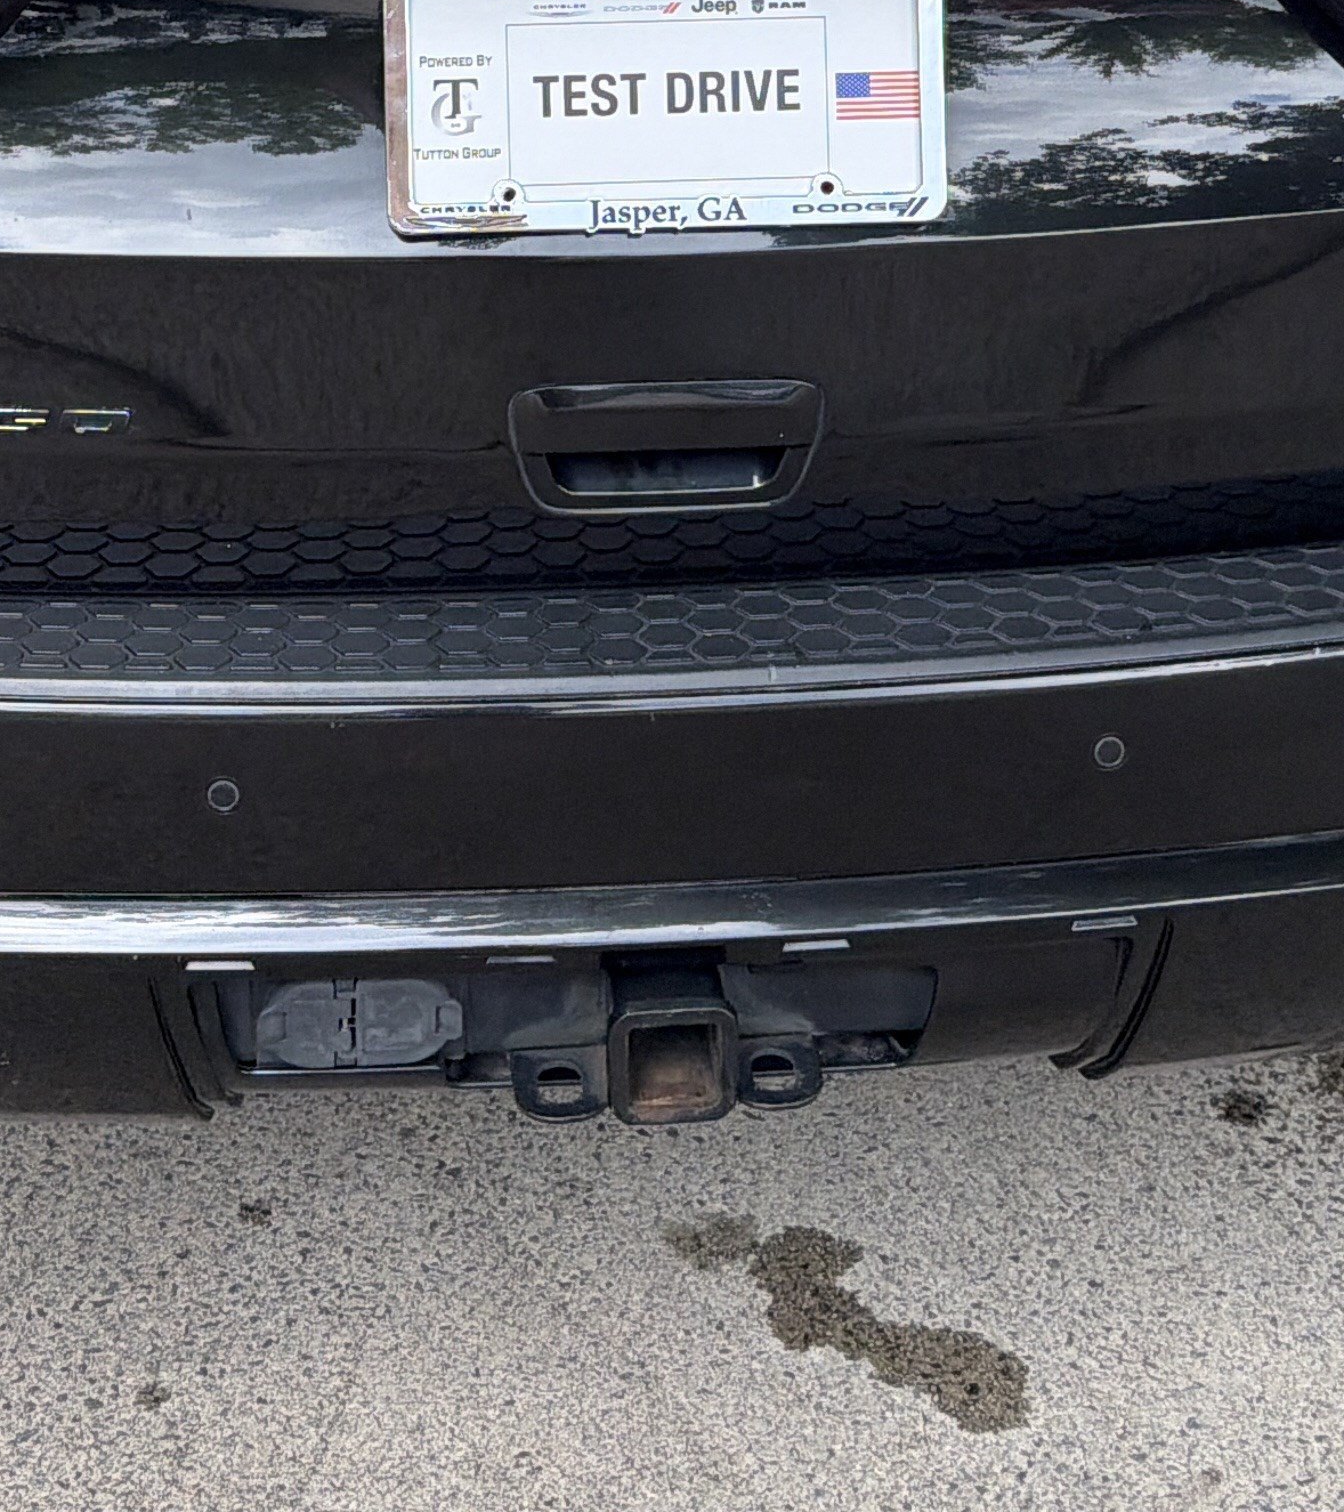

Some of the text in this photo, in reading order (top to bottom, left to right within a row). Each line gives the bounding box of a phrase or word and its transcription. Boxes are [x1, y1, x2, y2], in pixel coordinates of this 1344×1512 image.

[769, 1, 806, 9] RAM
[532, 69, 801, 118] TEST DRIVE
[420, 204, 512, 214] CHRYSLER
[589, 196, 748, 230] Jasper, GA
[792, 201, 910, 215] DODGE
